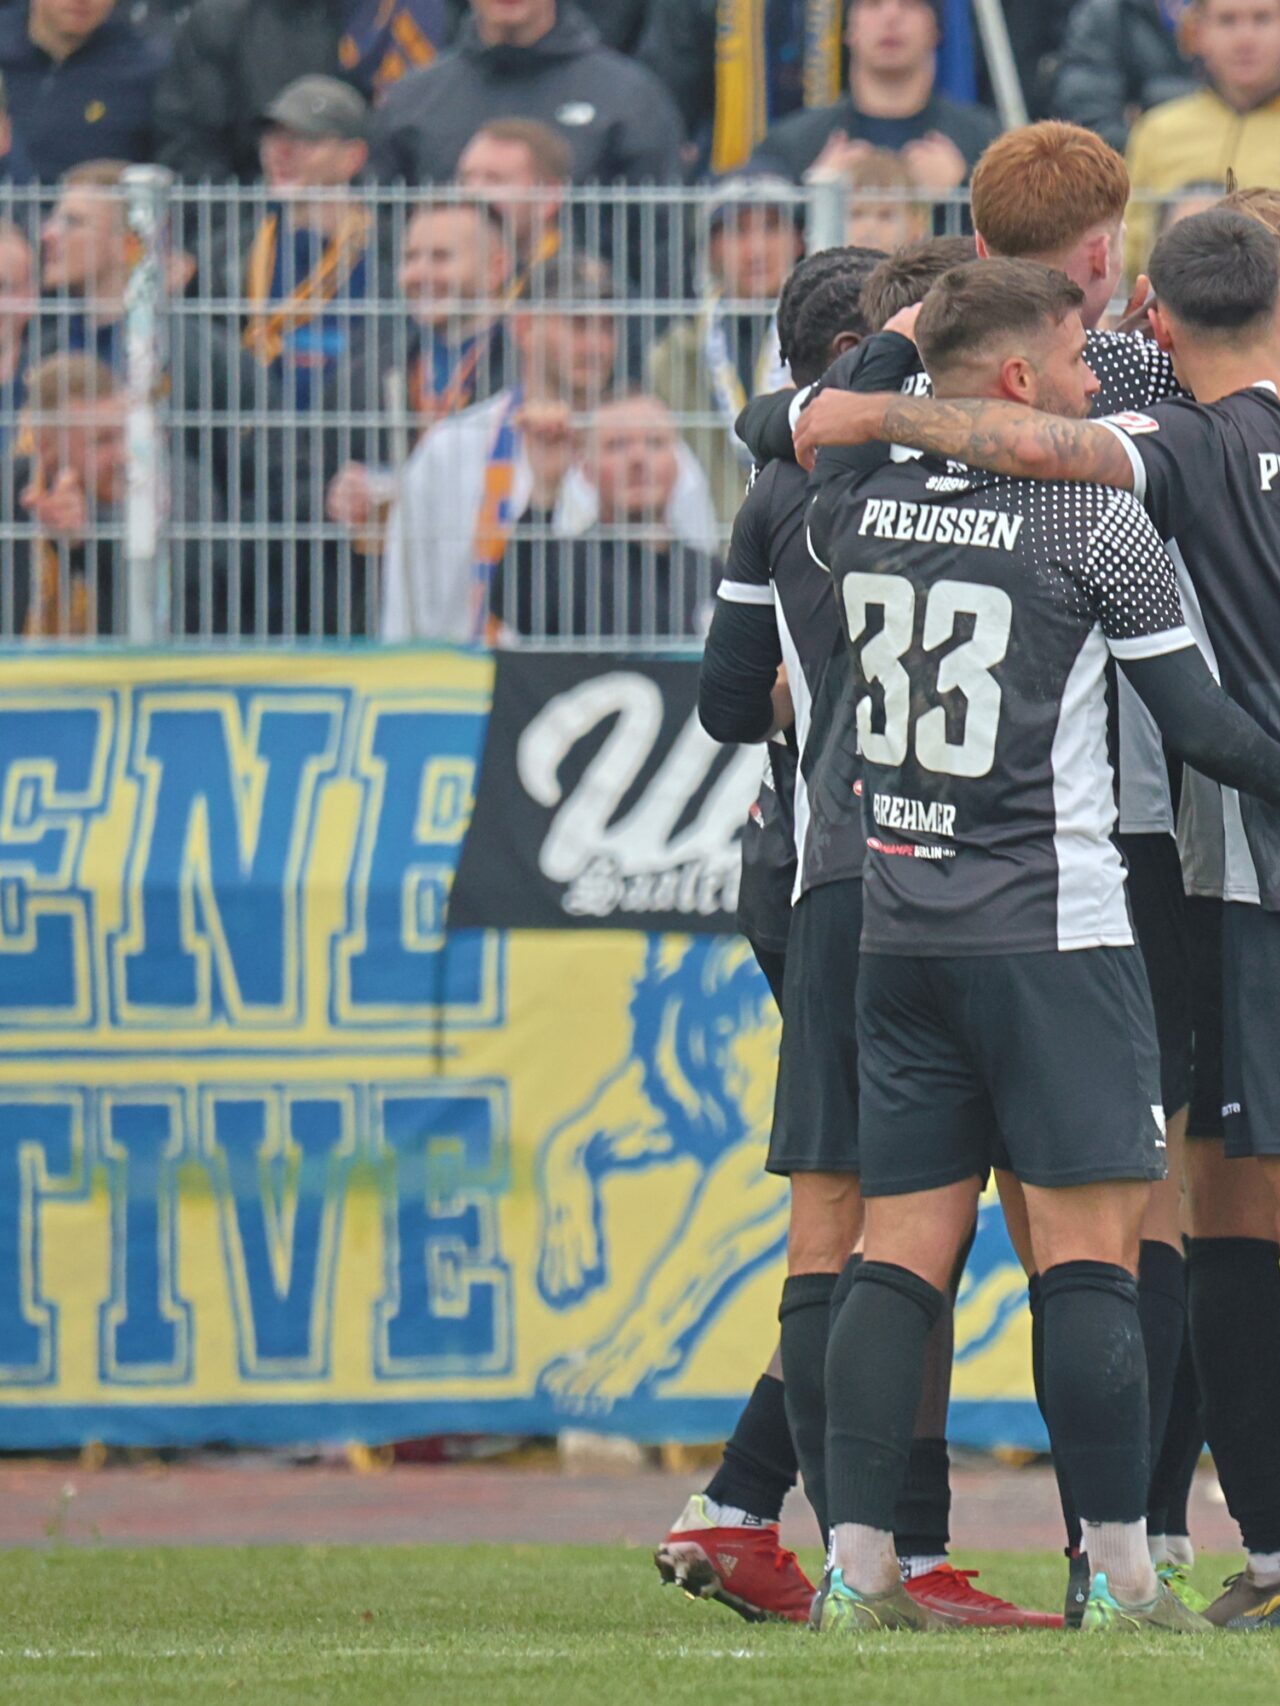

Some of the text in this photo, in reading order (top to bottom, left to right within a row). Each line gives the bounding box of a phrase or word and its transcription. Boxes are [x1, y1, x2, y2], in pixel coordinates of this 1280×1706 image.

[858, 498, 1024, 551] PREUSSEN
[842, 571, 1013, 778] 33
[873, 793, 956, 837] BREHMER
